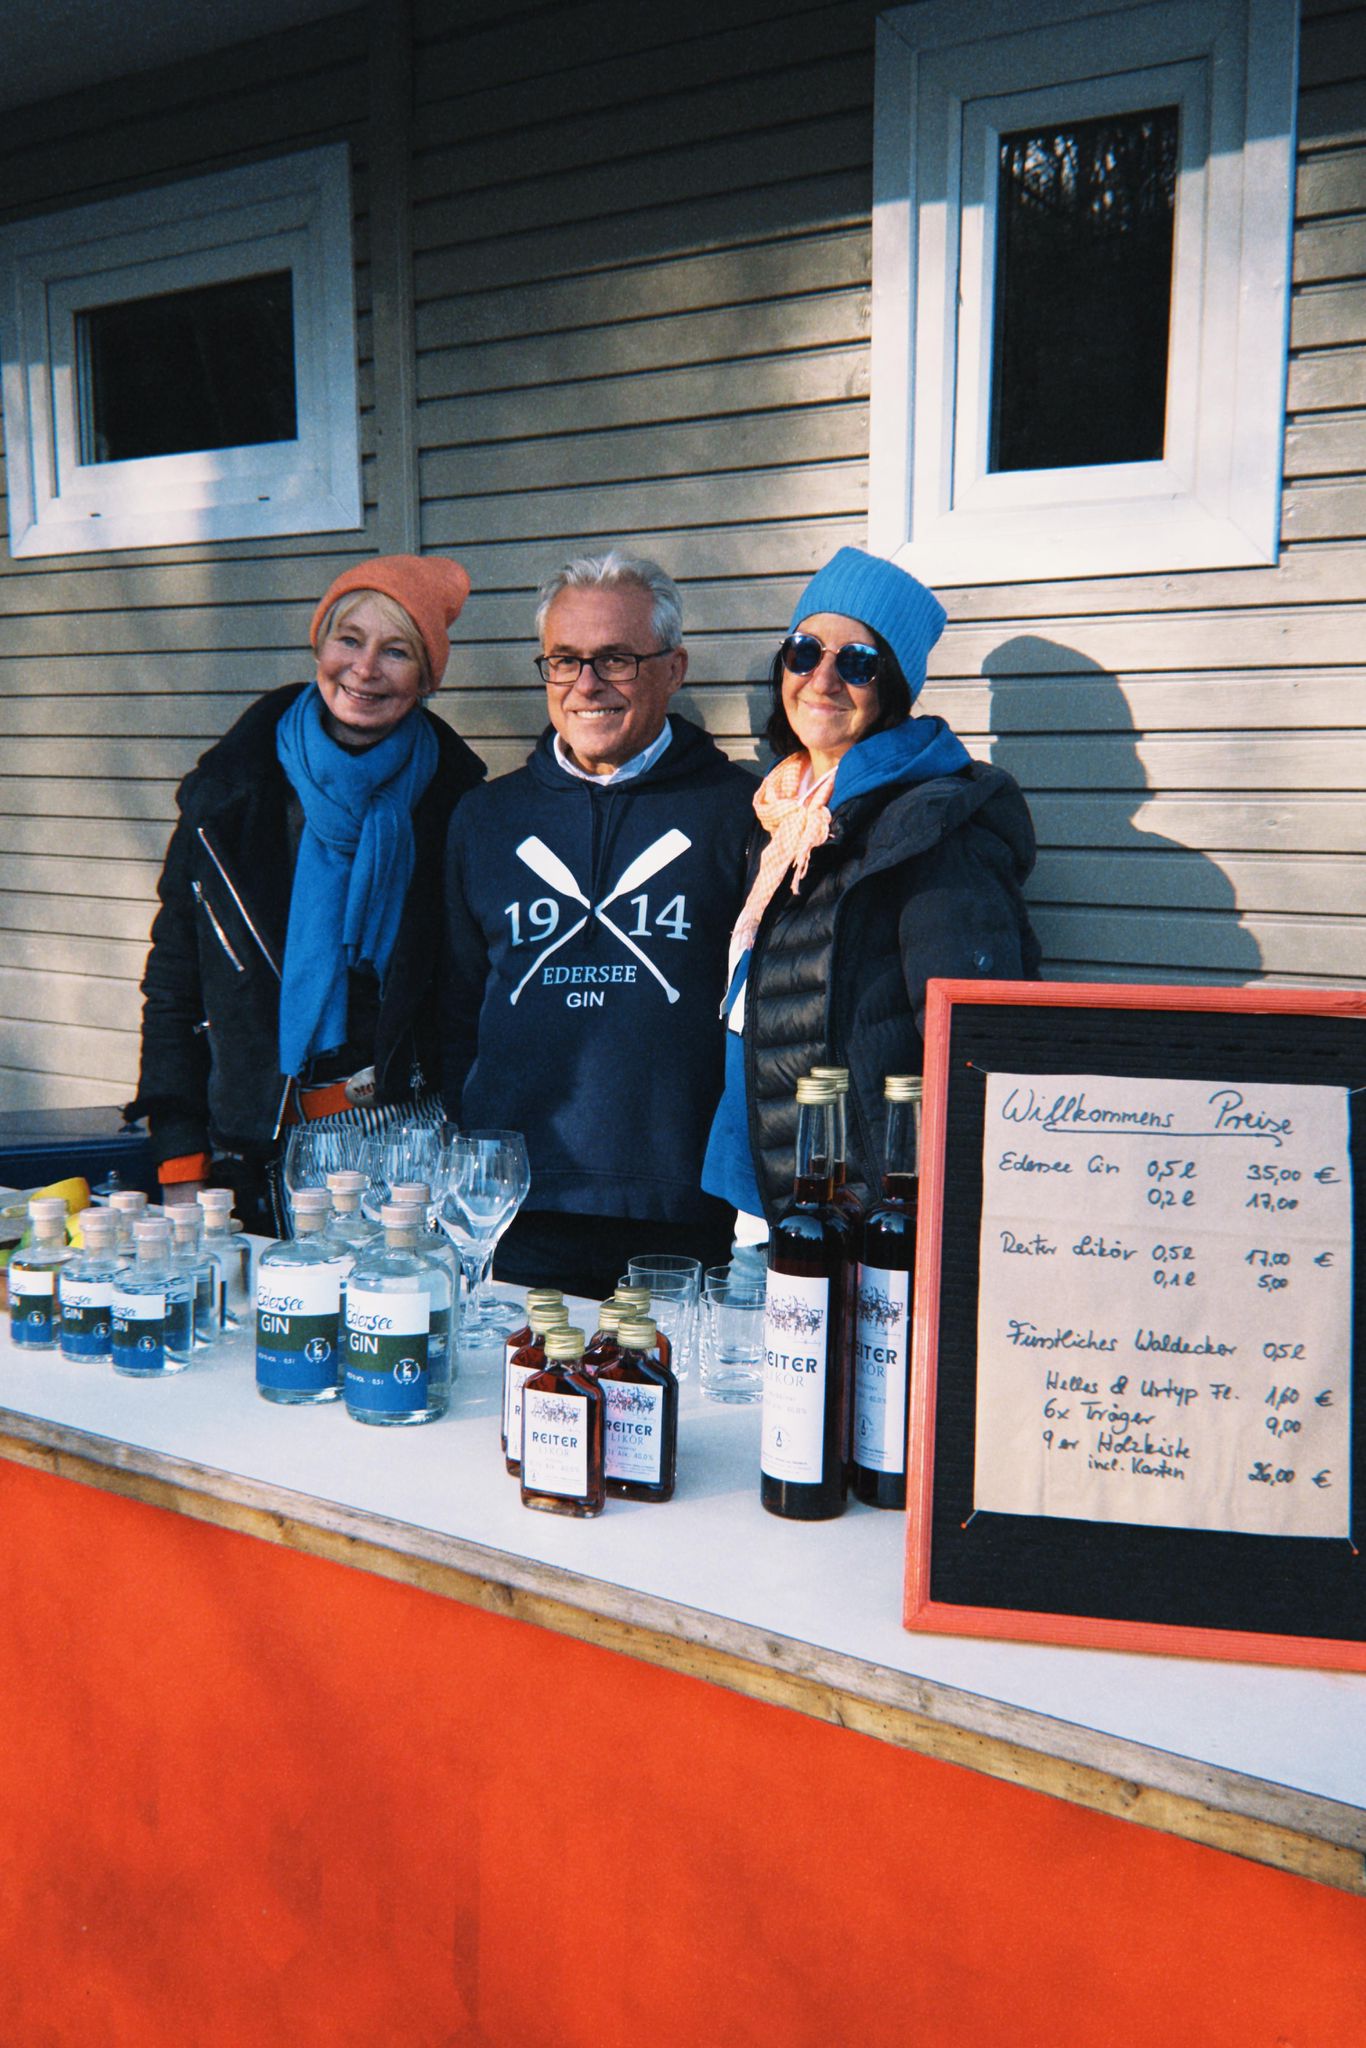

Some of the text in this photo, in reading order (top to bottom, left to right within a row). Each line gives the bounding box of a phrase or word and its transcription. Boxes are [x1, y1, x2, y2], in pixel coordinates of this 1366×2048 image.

[504, 893, 692, 947] 19 14
[542, 965, 637, 985] EDERSEE
[566, 991, 605, 1008] GIN
[1002, 1088, 1293, 1136] Willkommens Preise
[998, 1151, 1071, 1174] Edersee
[1246, 1164, 1302, 1186] 35,00
[1312, 1166, 1342, 1185] €
[1245, 1192, 1299, 1213] 17,00
[1000, 1230, 1057, 1256] Reiter
[1072, 1235, 1137, 1261] Likör
[1313, 1251, 1334, 1268] €
[1257, 1274, 1289, 1293] 5,00
[64, 1306, 83, 1320] GIN
[262, 1314, 289, 1335] GIN
[351, 1333, 378, 1354] GIN
[1046, 1370, 1098, 1394] Helles
[1109, 1375, 1129, 1395] &
[1140, 1378, 1198, 1407] Urtyp
[1313, 1389, 1334, 1408] €
[606, 1420, 653, 1436] REITER
[1043, 1398, 1070, 1419] 6x
[1265, 1416, 1302, 1439] 9,00
[532, 1431, 579, 1448] REITER
[1096, 1429, 1190, 1462] Holzkiste
[1311, 1468, 1331, 1489] €
